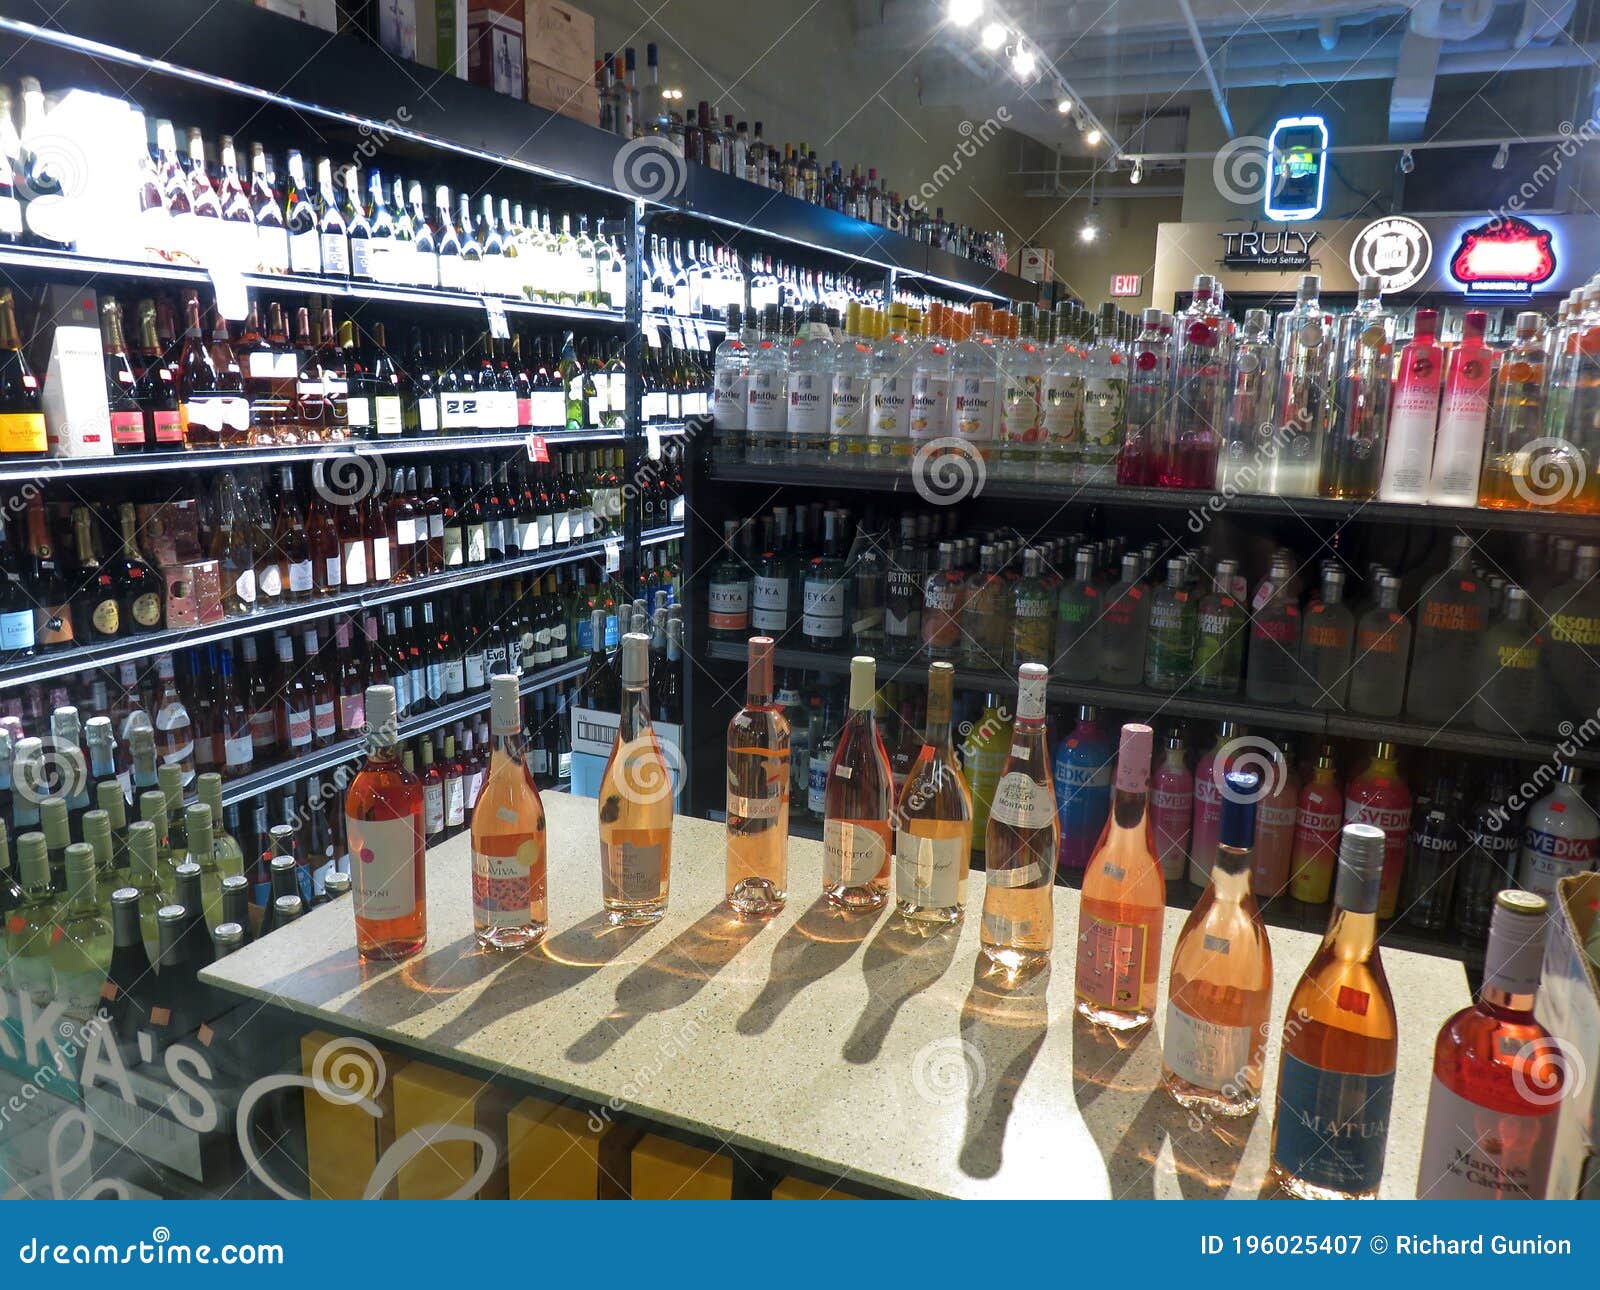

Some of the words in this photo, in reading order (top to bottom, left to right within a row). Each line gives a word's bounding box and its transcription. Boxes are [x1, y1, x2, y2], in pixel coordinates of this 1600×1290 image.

[1223, 232, 1317, 255] TRULY
[1115, 275, 1139, 293] EXIT
[712, 592, 742, 601] REYKA
[1552, 614, 1600, 632] ABSOLU
[1000, 797, 1034, 812] MONTAUD
[1298, 813, 1336, 828] VEDKA
[1357, 809, 1408, 826] SVEDK
[1526, 828, 1590, 857] SVEDKA
